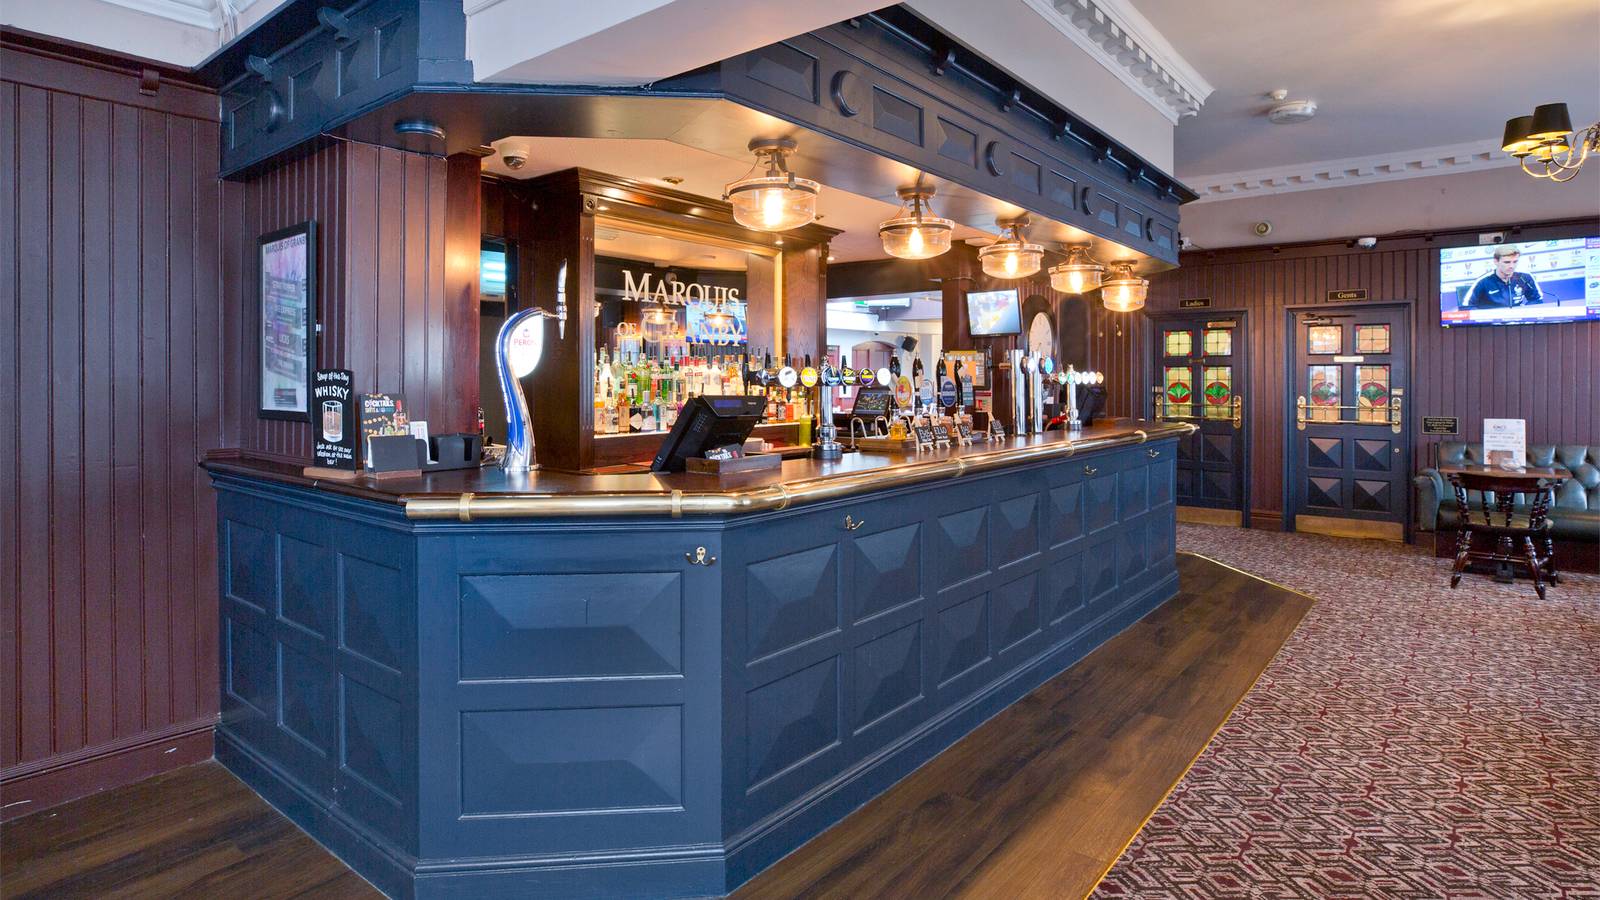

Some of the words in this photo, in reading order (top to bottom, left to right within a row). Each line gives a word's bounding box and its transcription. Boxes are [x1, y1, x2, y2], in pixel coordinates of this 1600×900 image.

[290, 236, 306, 249] GRANB
[622, 269, 740, 311] MARQUIS
[1337, 291, 1357, 299] Gents
[1185, 299, 1204, 307] Ladies
[314, 385, 350, 400] WHISKY
[364, 399, 395, 408] COCKTAILS
